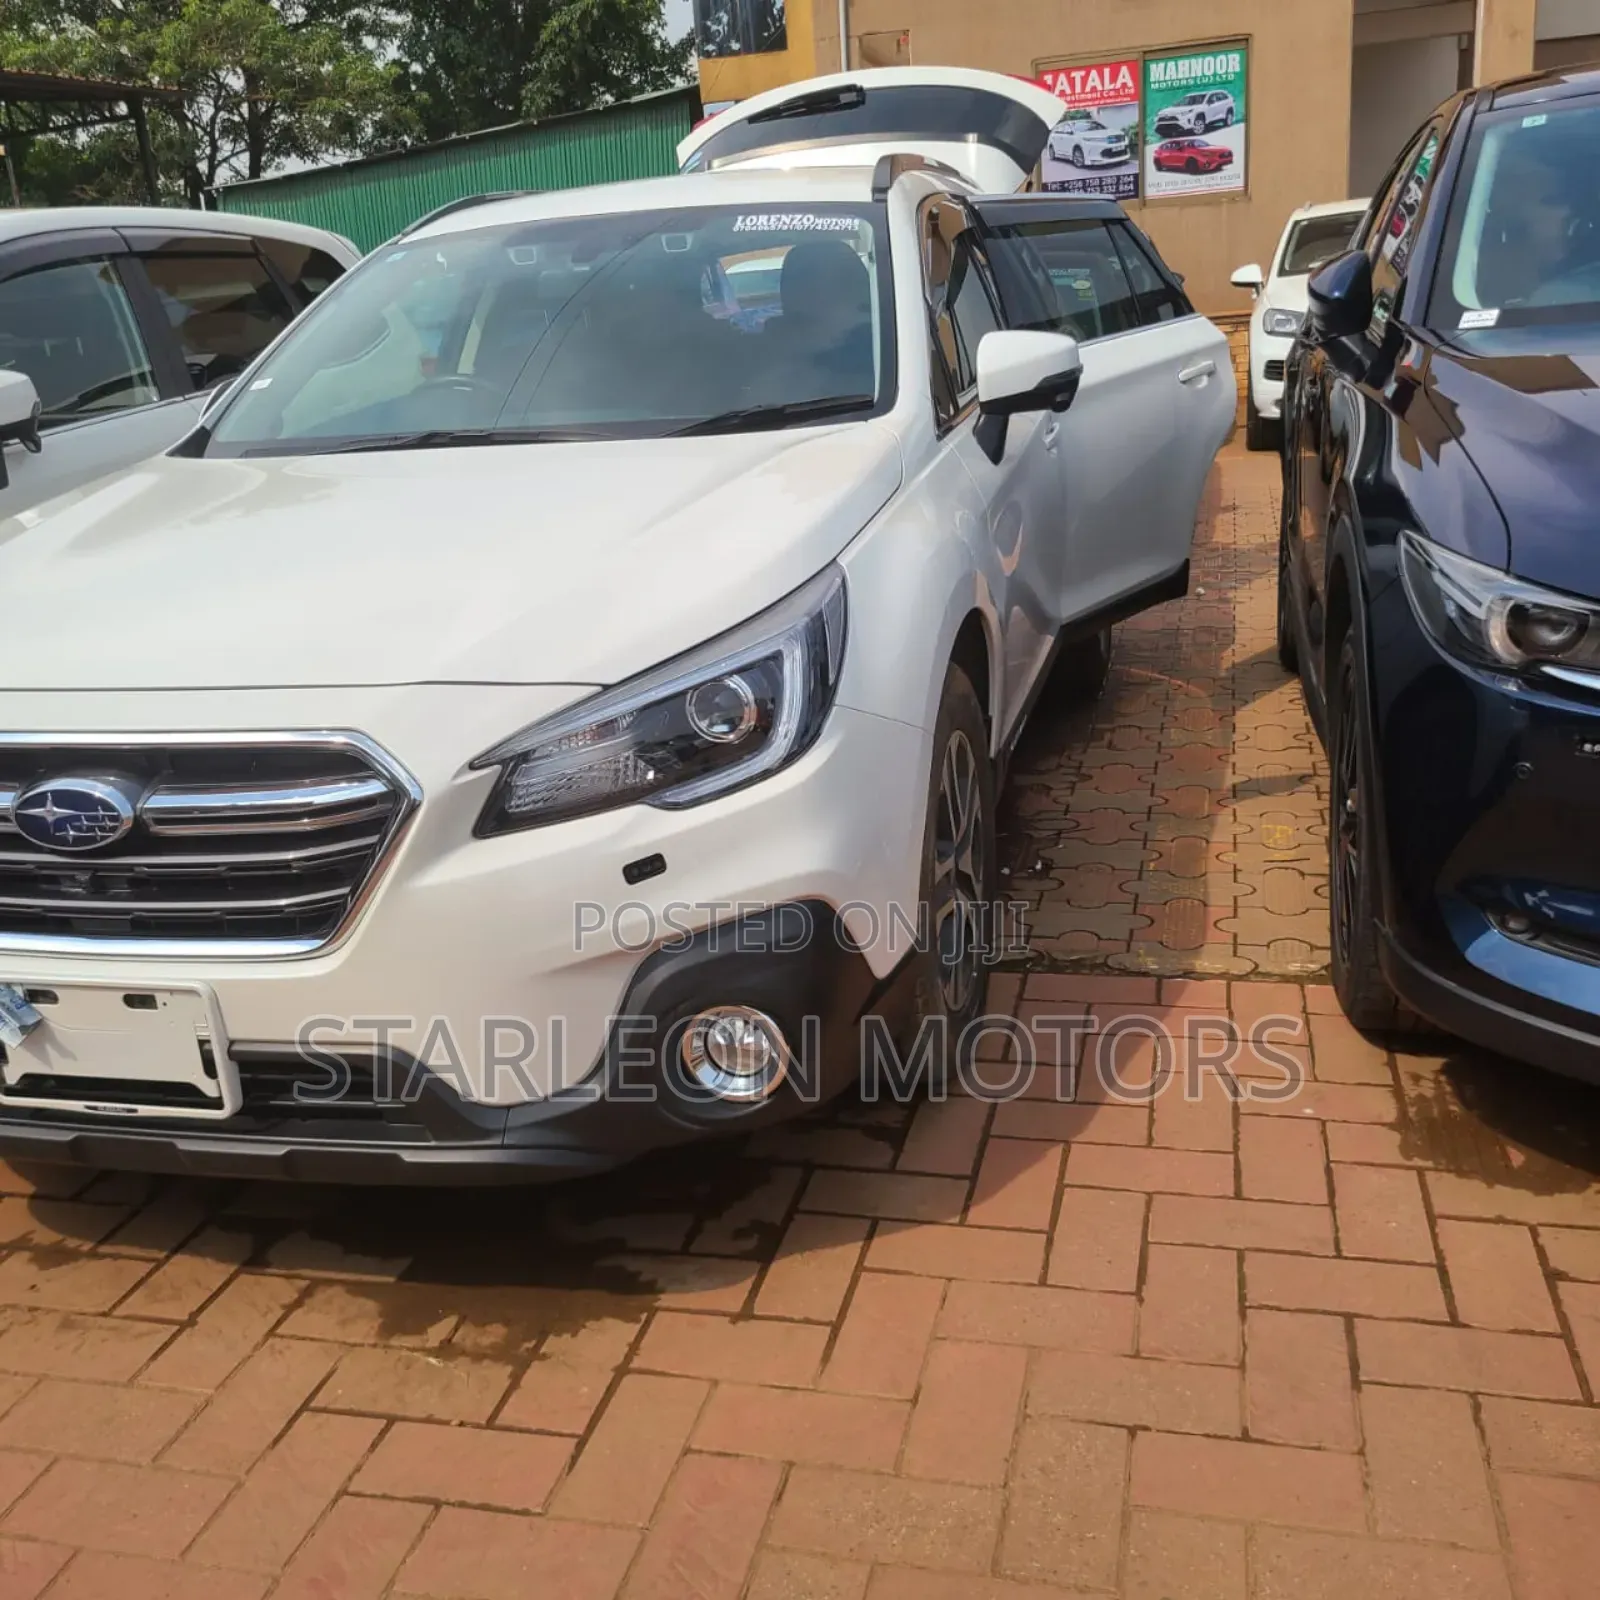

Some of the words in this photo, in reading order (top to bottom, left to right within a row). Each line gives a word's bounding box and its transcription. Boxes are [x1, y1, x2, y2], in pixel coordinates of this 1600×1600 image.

[1150, 54, 1240, 82] MAHNOOR
[1151, 79, 1194, 90] MOTORS
[1216, 73, 1235, 82] LTD
[737, 214, 815, 226] LORENZO
[814, 218, 860, 227] MOTORS
